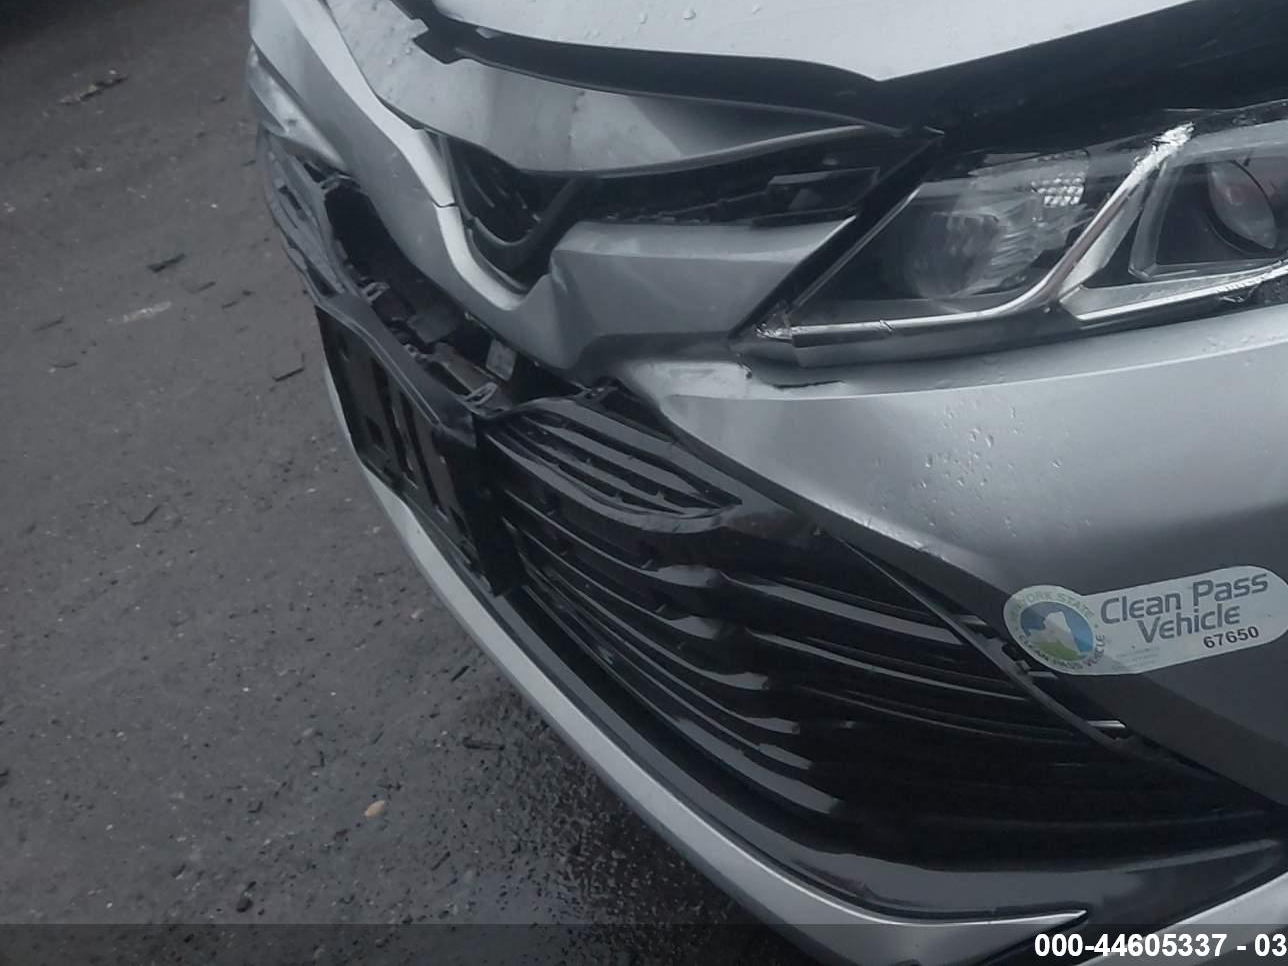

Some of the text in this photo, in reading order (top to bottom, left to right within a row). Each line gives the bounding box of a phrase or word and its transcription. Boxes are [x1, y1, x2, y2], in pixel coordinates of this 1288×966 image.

[1100, 573, 1270, 625] Clean Pass
[1137, 602, 1241, 644] Vehicle
[1202, 625, 1260, 649] 67650
